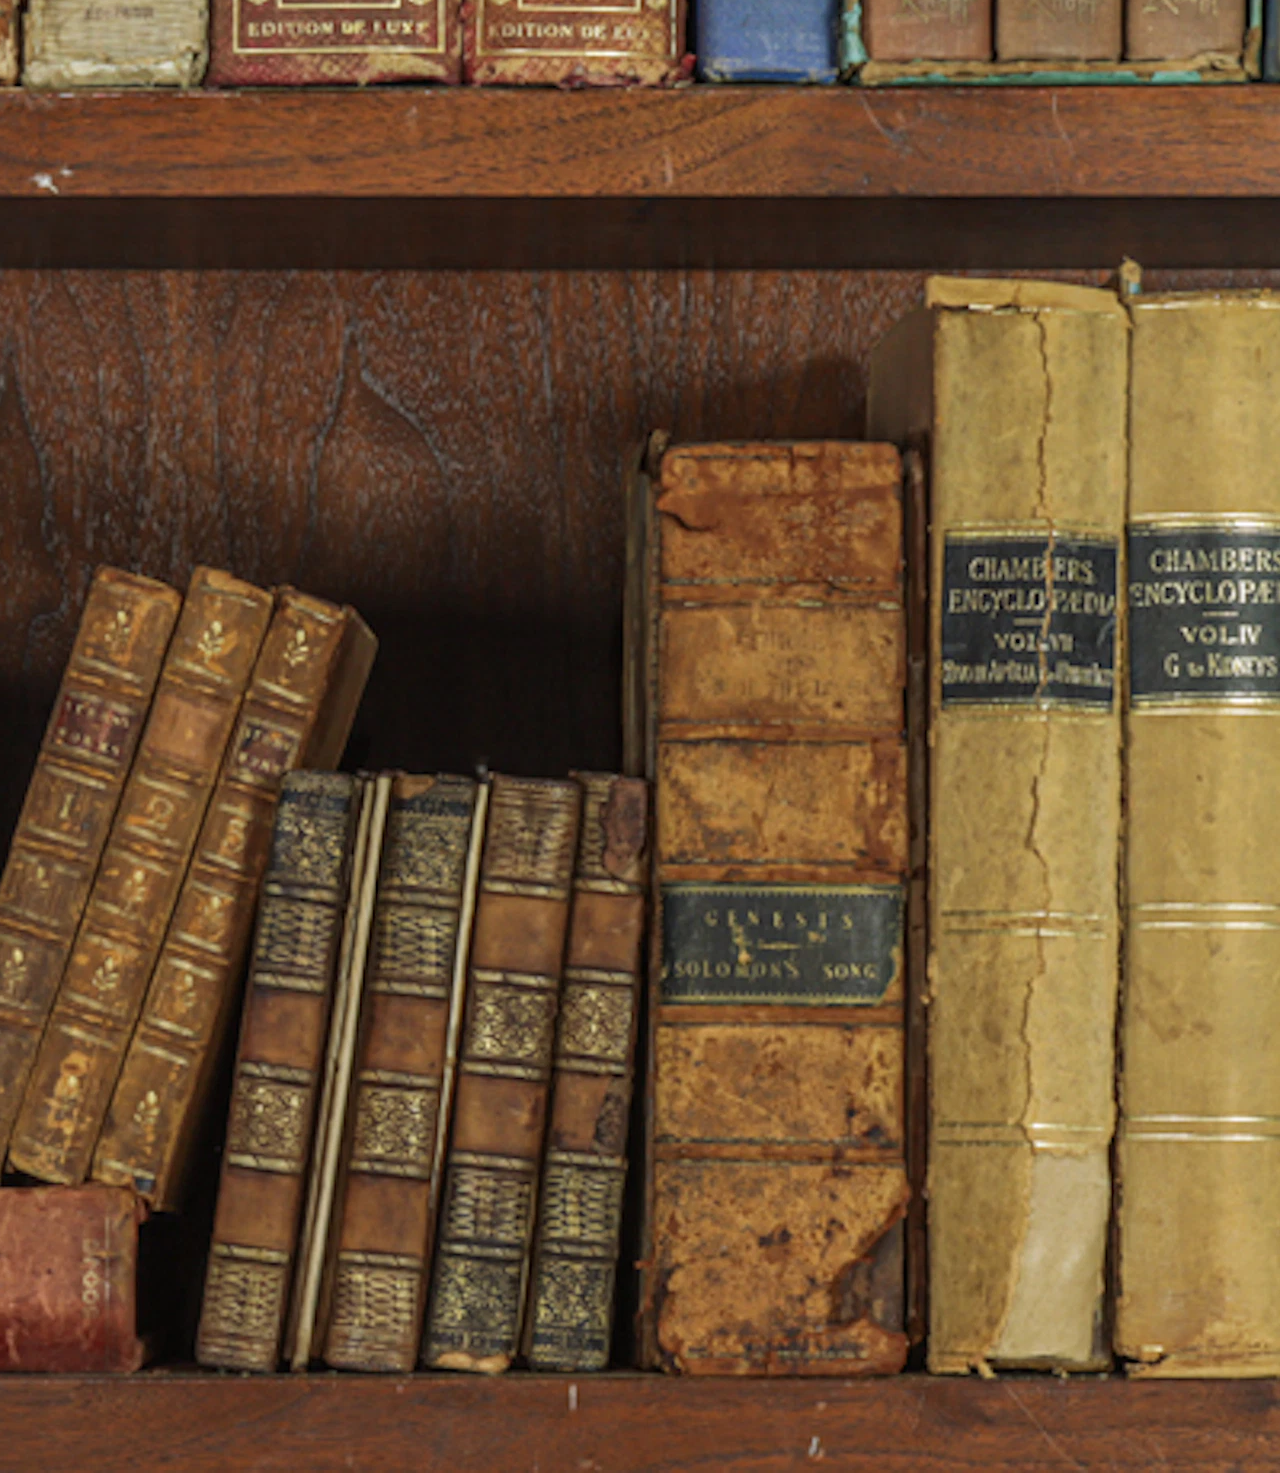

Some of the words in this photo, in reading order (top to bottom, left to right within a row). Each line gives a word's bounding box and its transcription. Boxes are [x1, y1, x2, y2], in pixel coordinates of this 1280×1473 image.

[248, 21, 334, 38] EDITION
[342, 20, 368, 35] DE
[373, 19, 429, 36] LUXE
[581, 25, 607, 40] DE
[970, 557, 1097, 584] CHAMBERS
[1163, 653, 1180, 678] G
[822, 962, 878, 981] SONG
